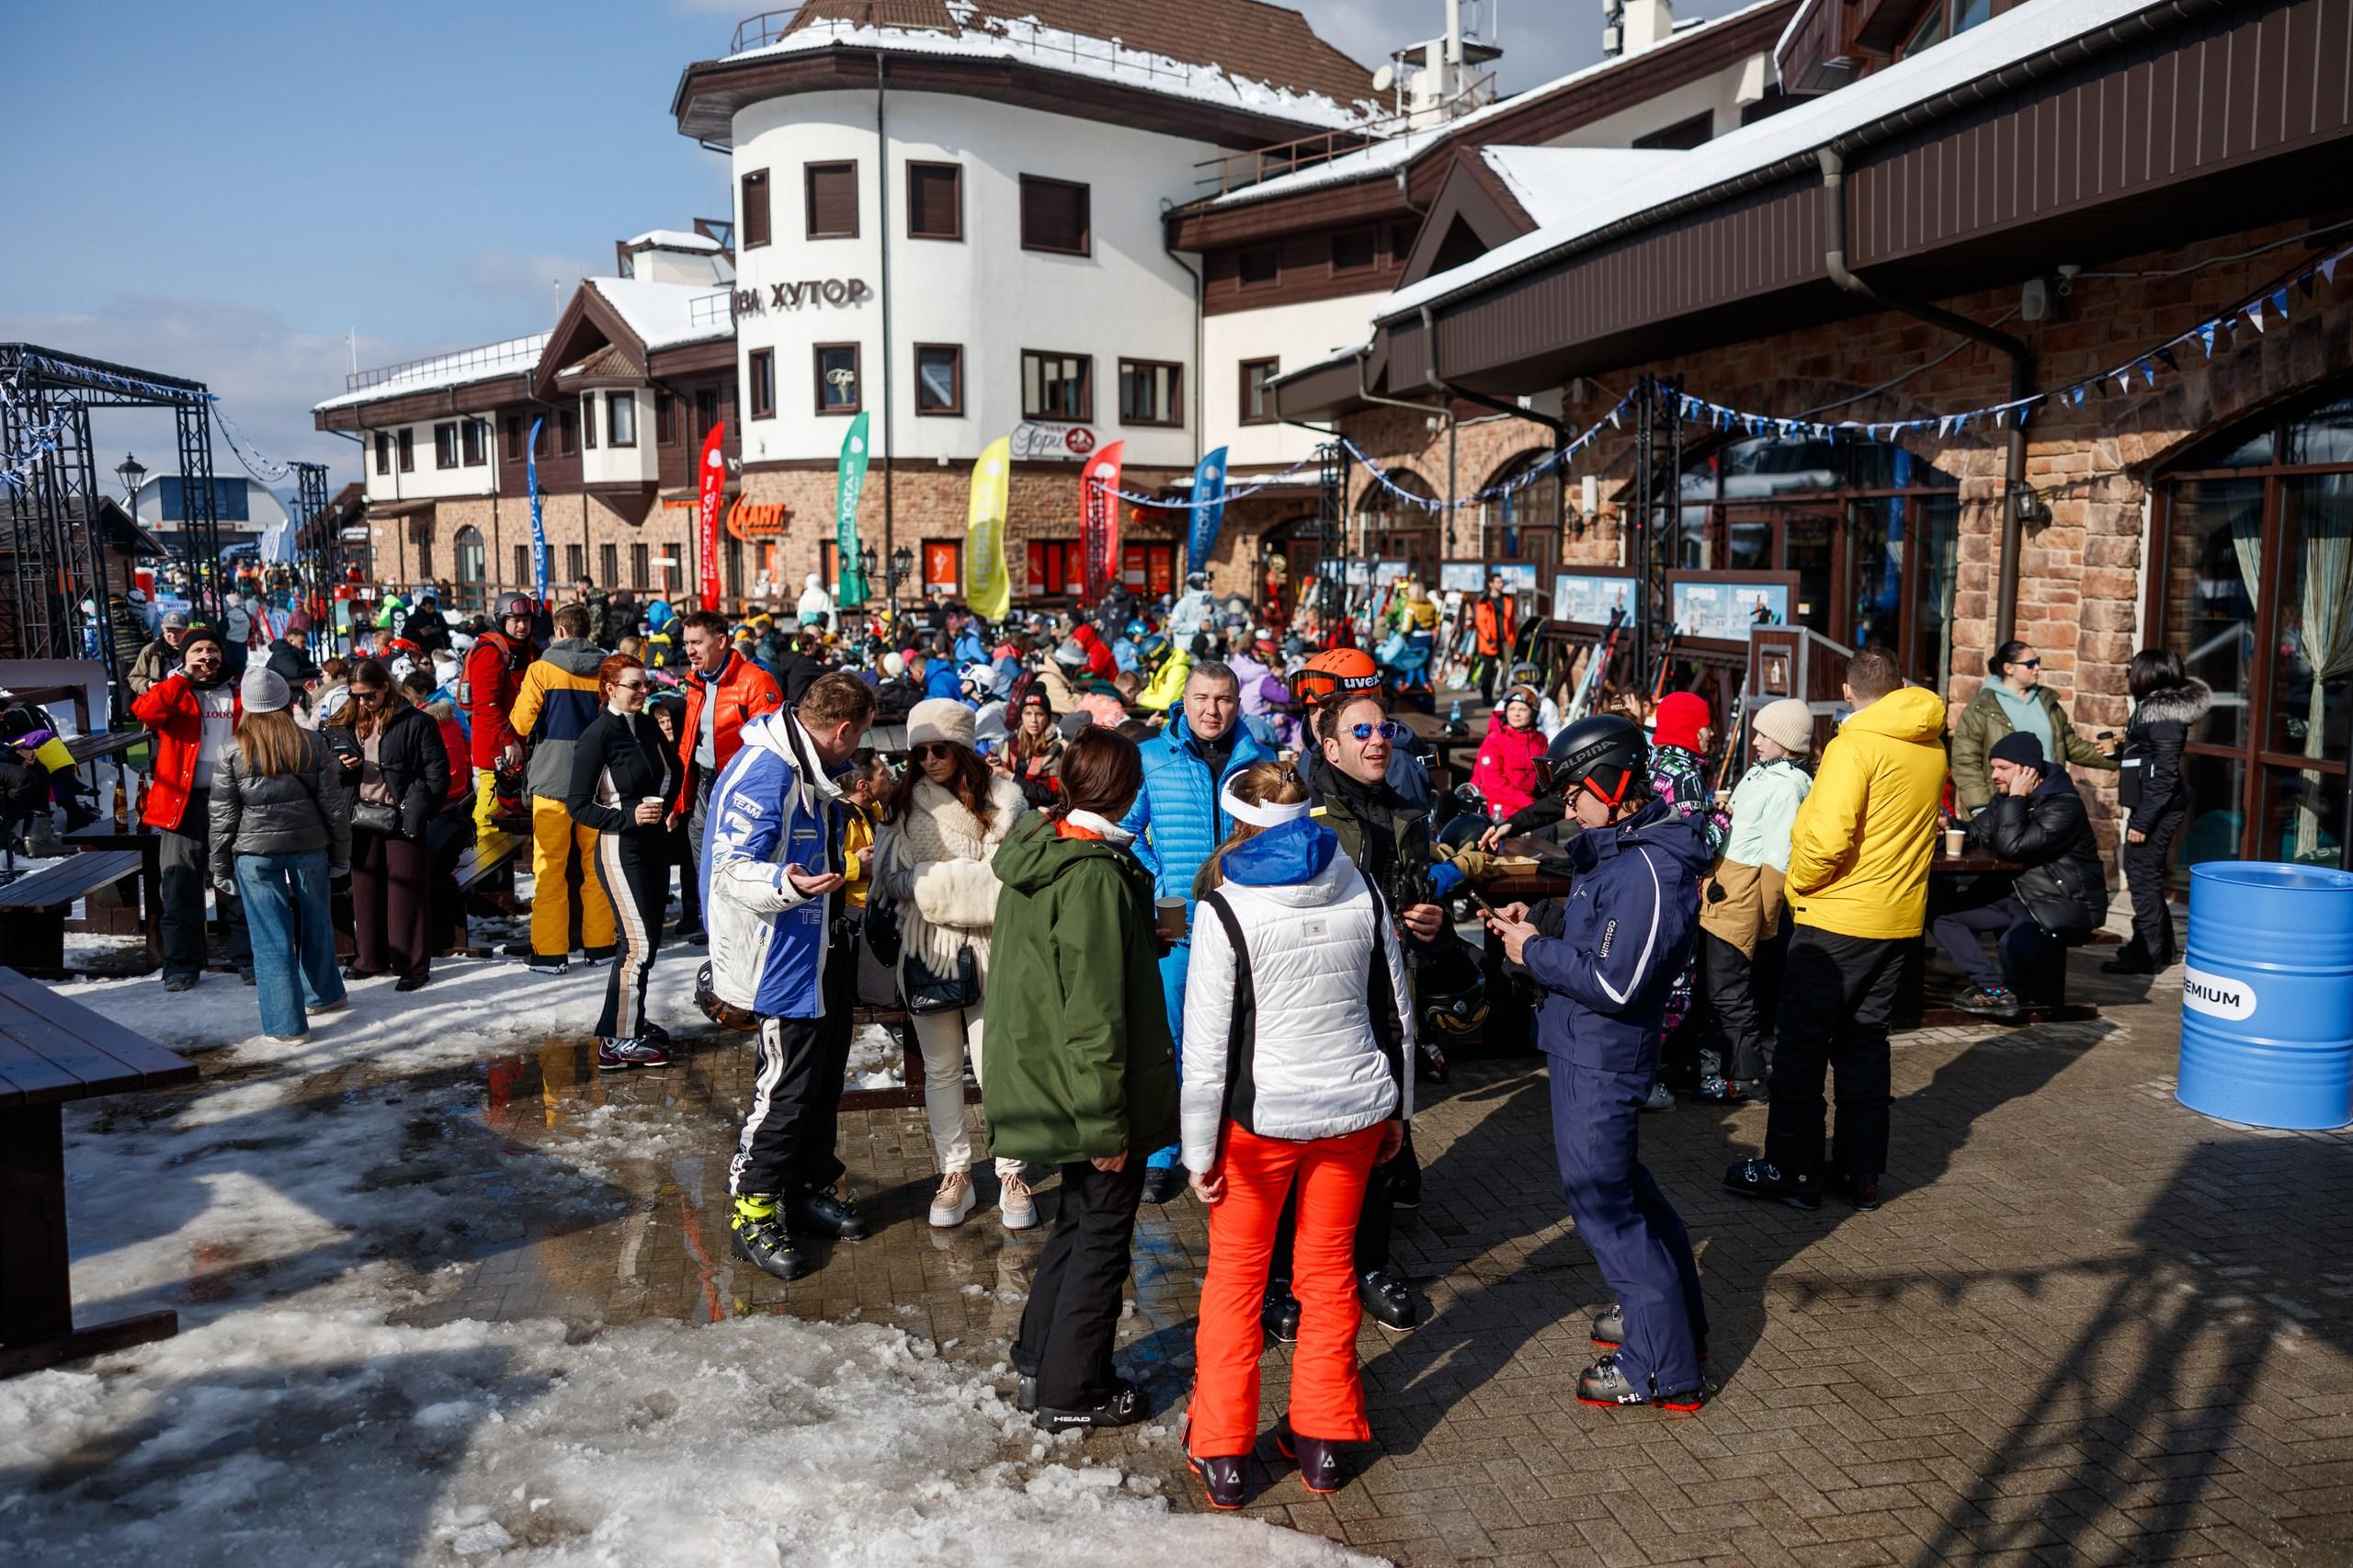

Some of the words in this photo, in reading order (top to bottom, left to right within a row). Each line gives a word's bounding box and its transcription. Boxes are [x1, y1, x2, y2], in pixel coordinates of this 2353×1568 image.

[732, 287, 760, 314] ОЗА
[770, 278, 866, 308] ХУТОР
[736, 504, 785, 527] КАНТ
[841, 476, 855, 553] ЕРЛОГА
[1344, 674, 1380, 688] uvex
[1554, 740, 1619, 776] ALPINA
[732, 796, 762, 819] TEAM
